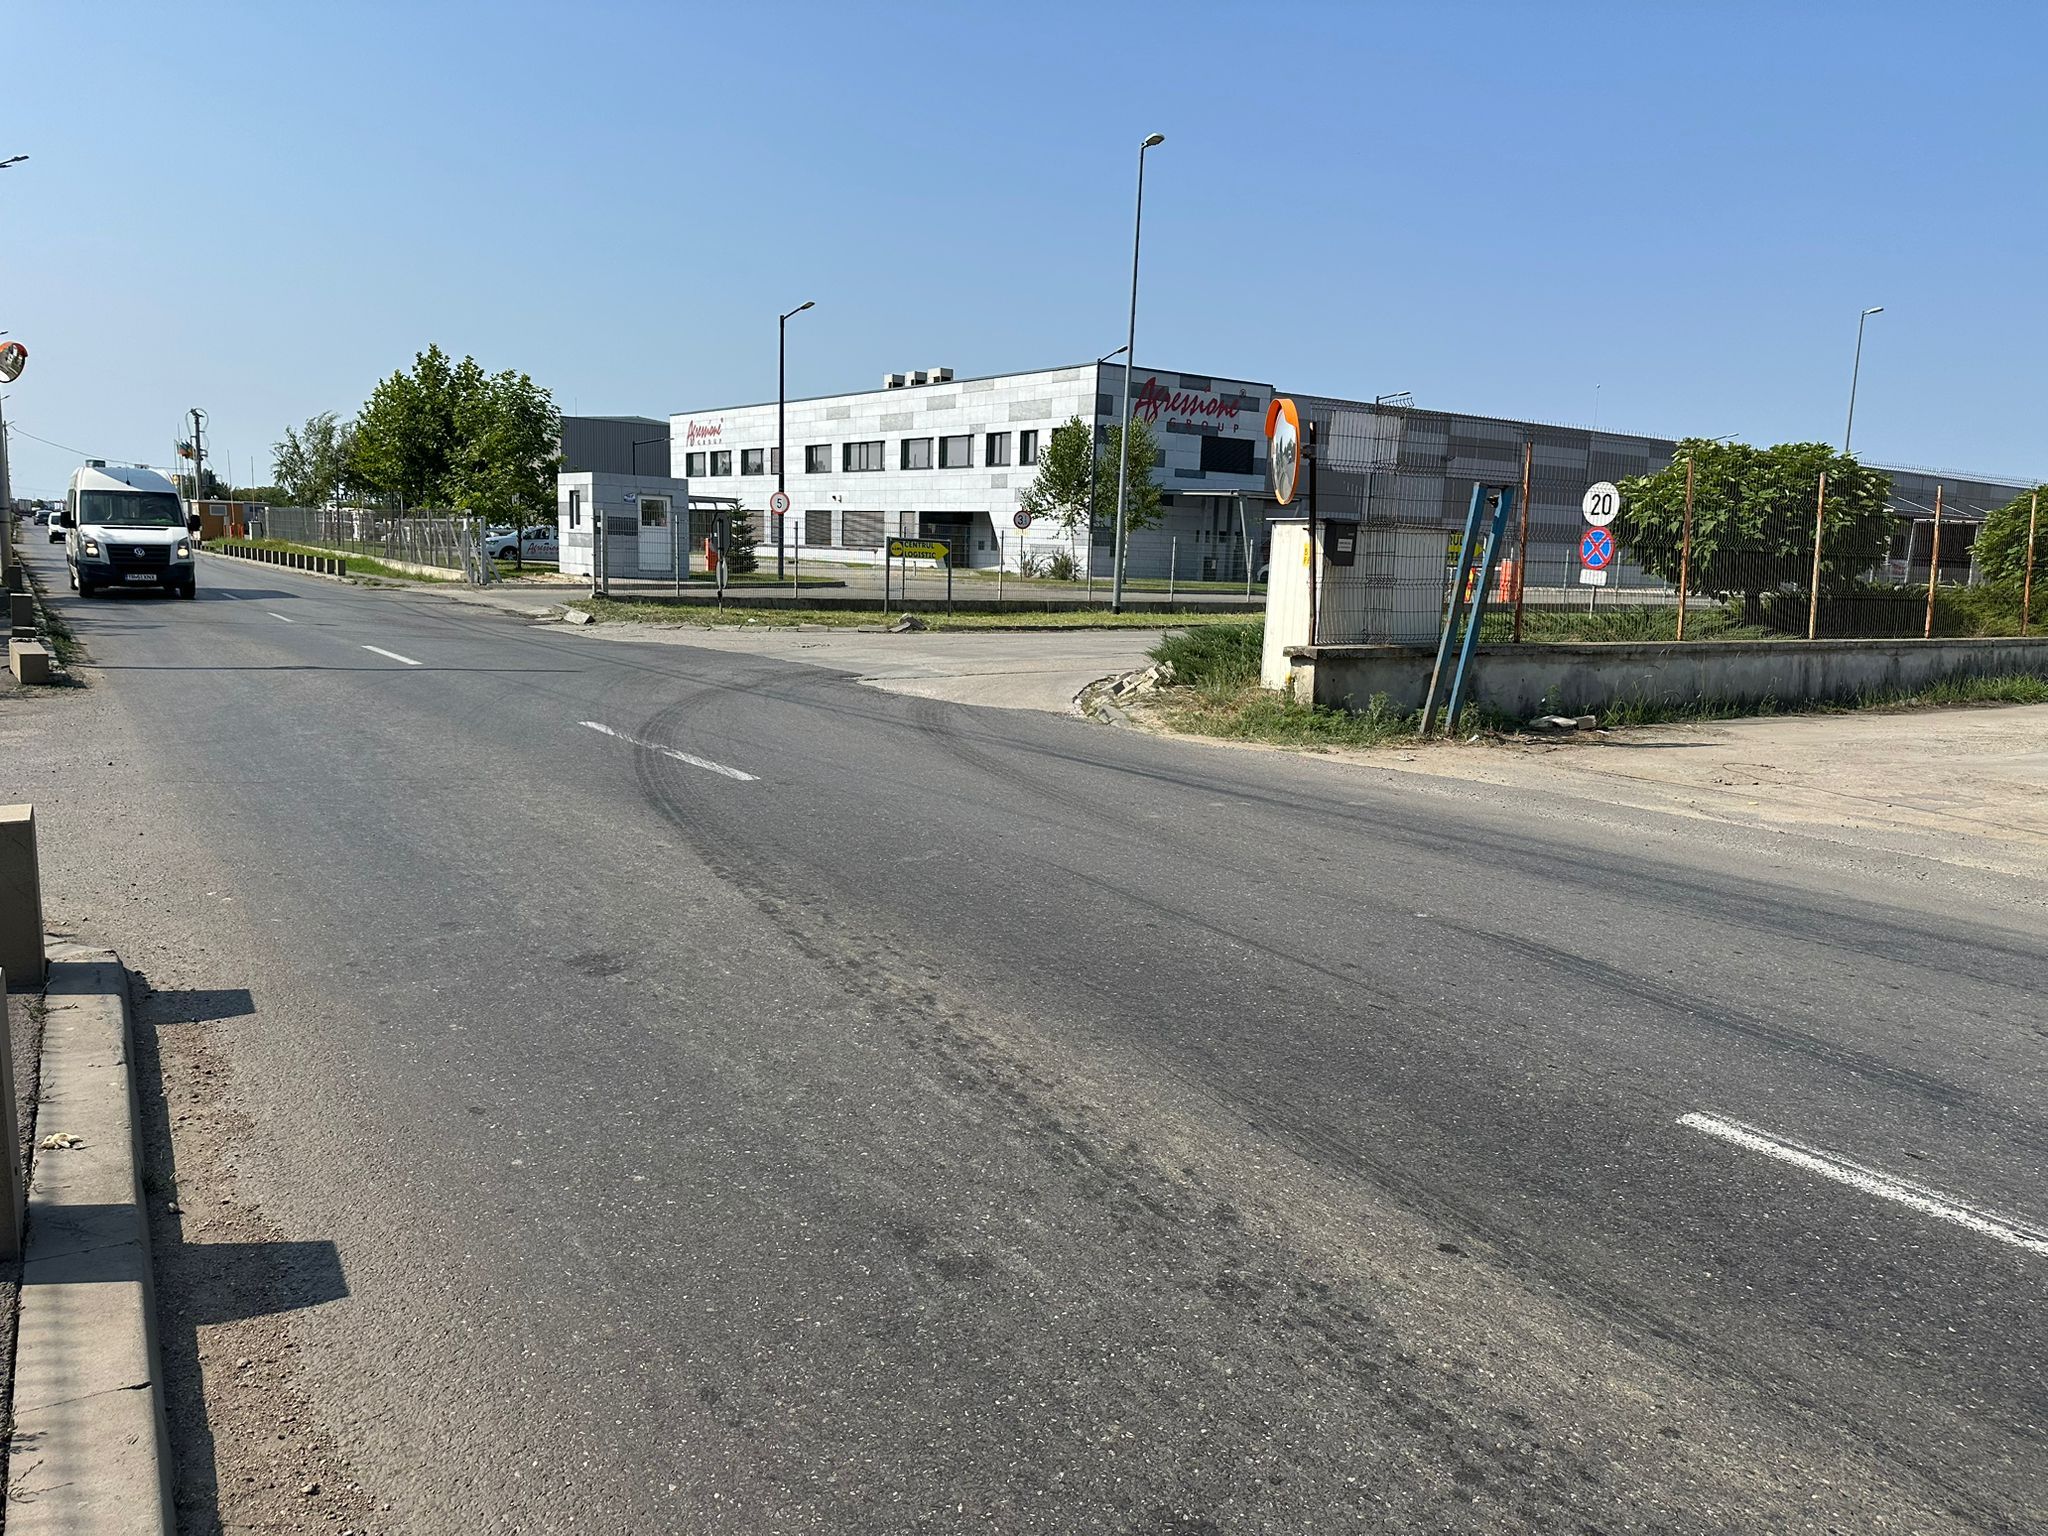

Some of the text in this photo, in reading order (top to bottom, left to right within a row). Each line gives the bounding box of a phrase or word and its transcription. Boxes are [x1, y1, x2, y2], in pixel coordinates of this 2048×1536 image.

[1133, 376, 1240, 425] Agressione
[1169, 417, 1240, 433] GROUP
[776, 498, 783, 509] 5
[1591, 493, 1612, 515] 20
[904, 541, 935, 549] CENTRUL
[904, 551, 937, 559] LOGISTIC
